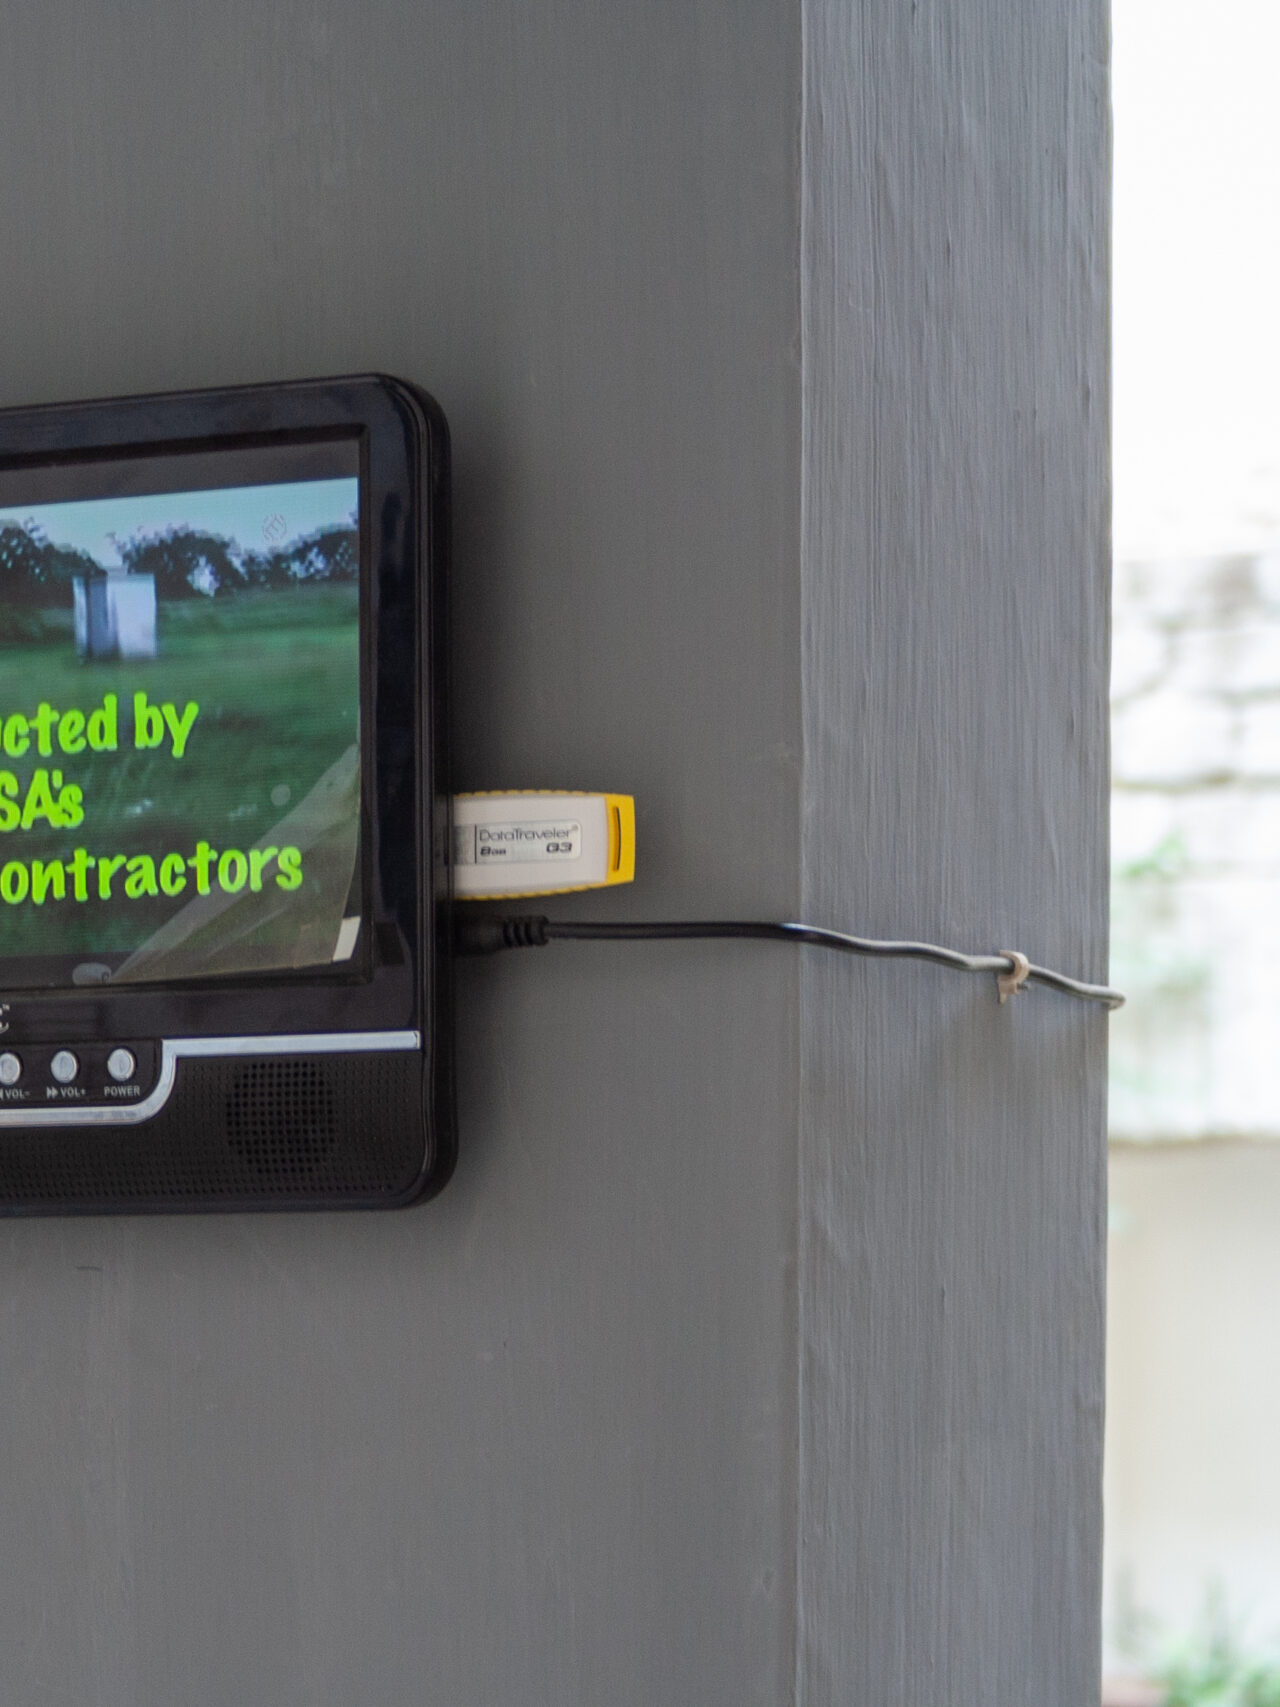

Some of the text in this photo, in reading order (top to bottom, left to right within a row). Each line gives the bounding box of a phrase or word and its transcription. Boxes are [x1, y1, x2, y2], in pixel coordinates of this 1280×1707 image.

[133, 691, 200, 757] by
[546, 842, 573, 853] G3
[60, 1087, 87, 1097] VOL+
[103, 1085, 141, 1097] POWER
